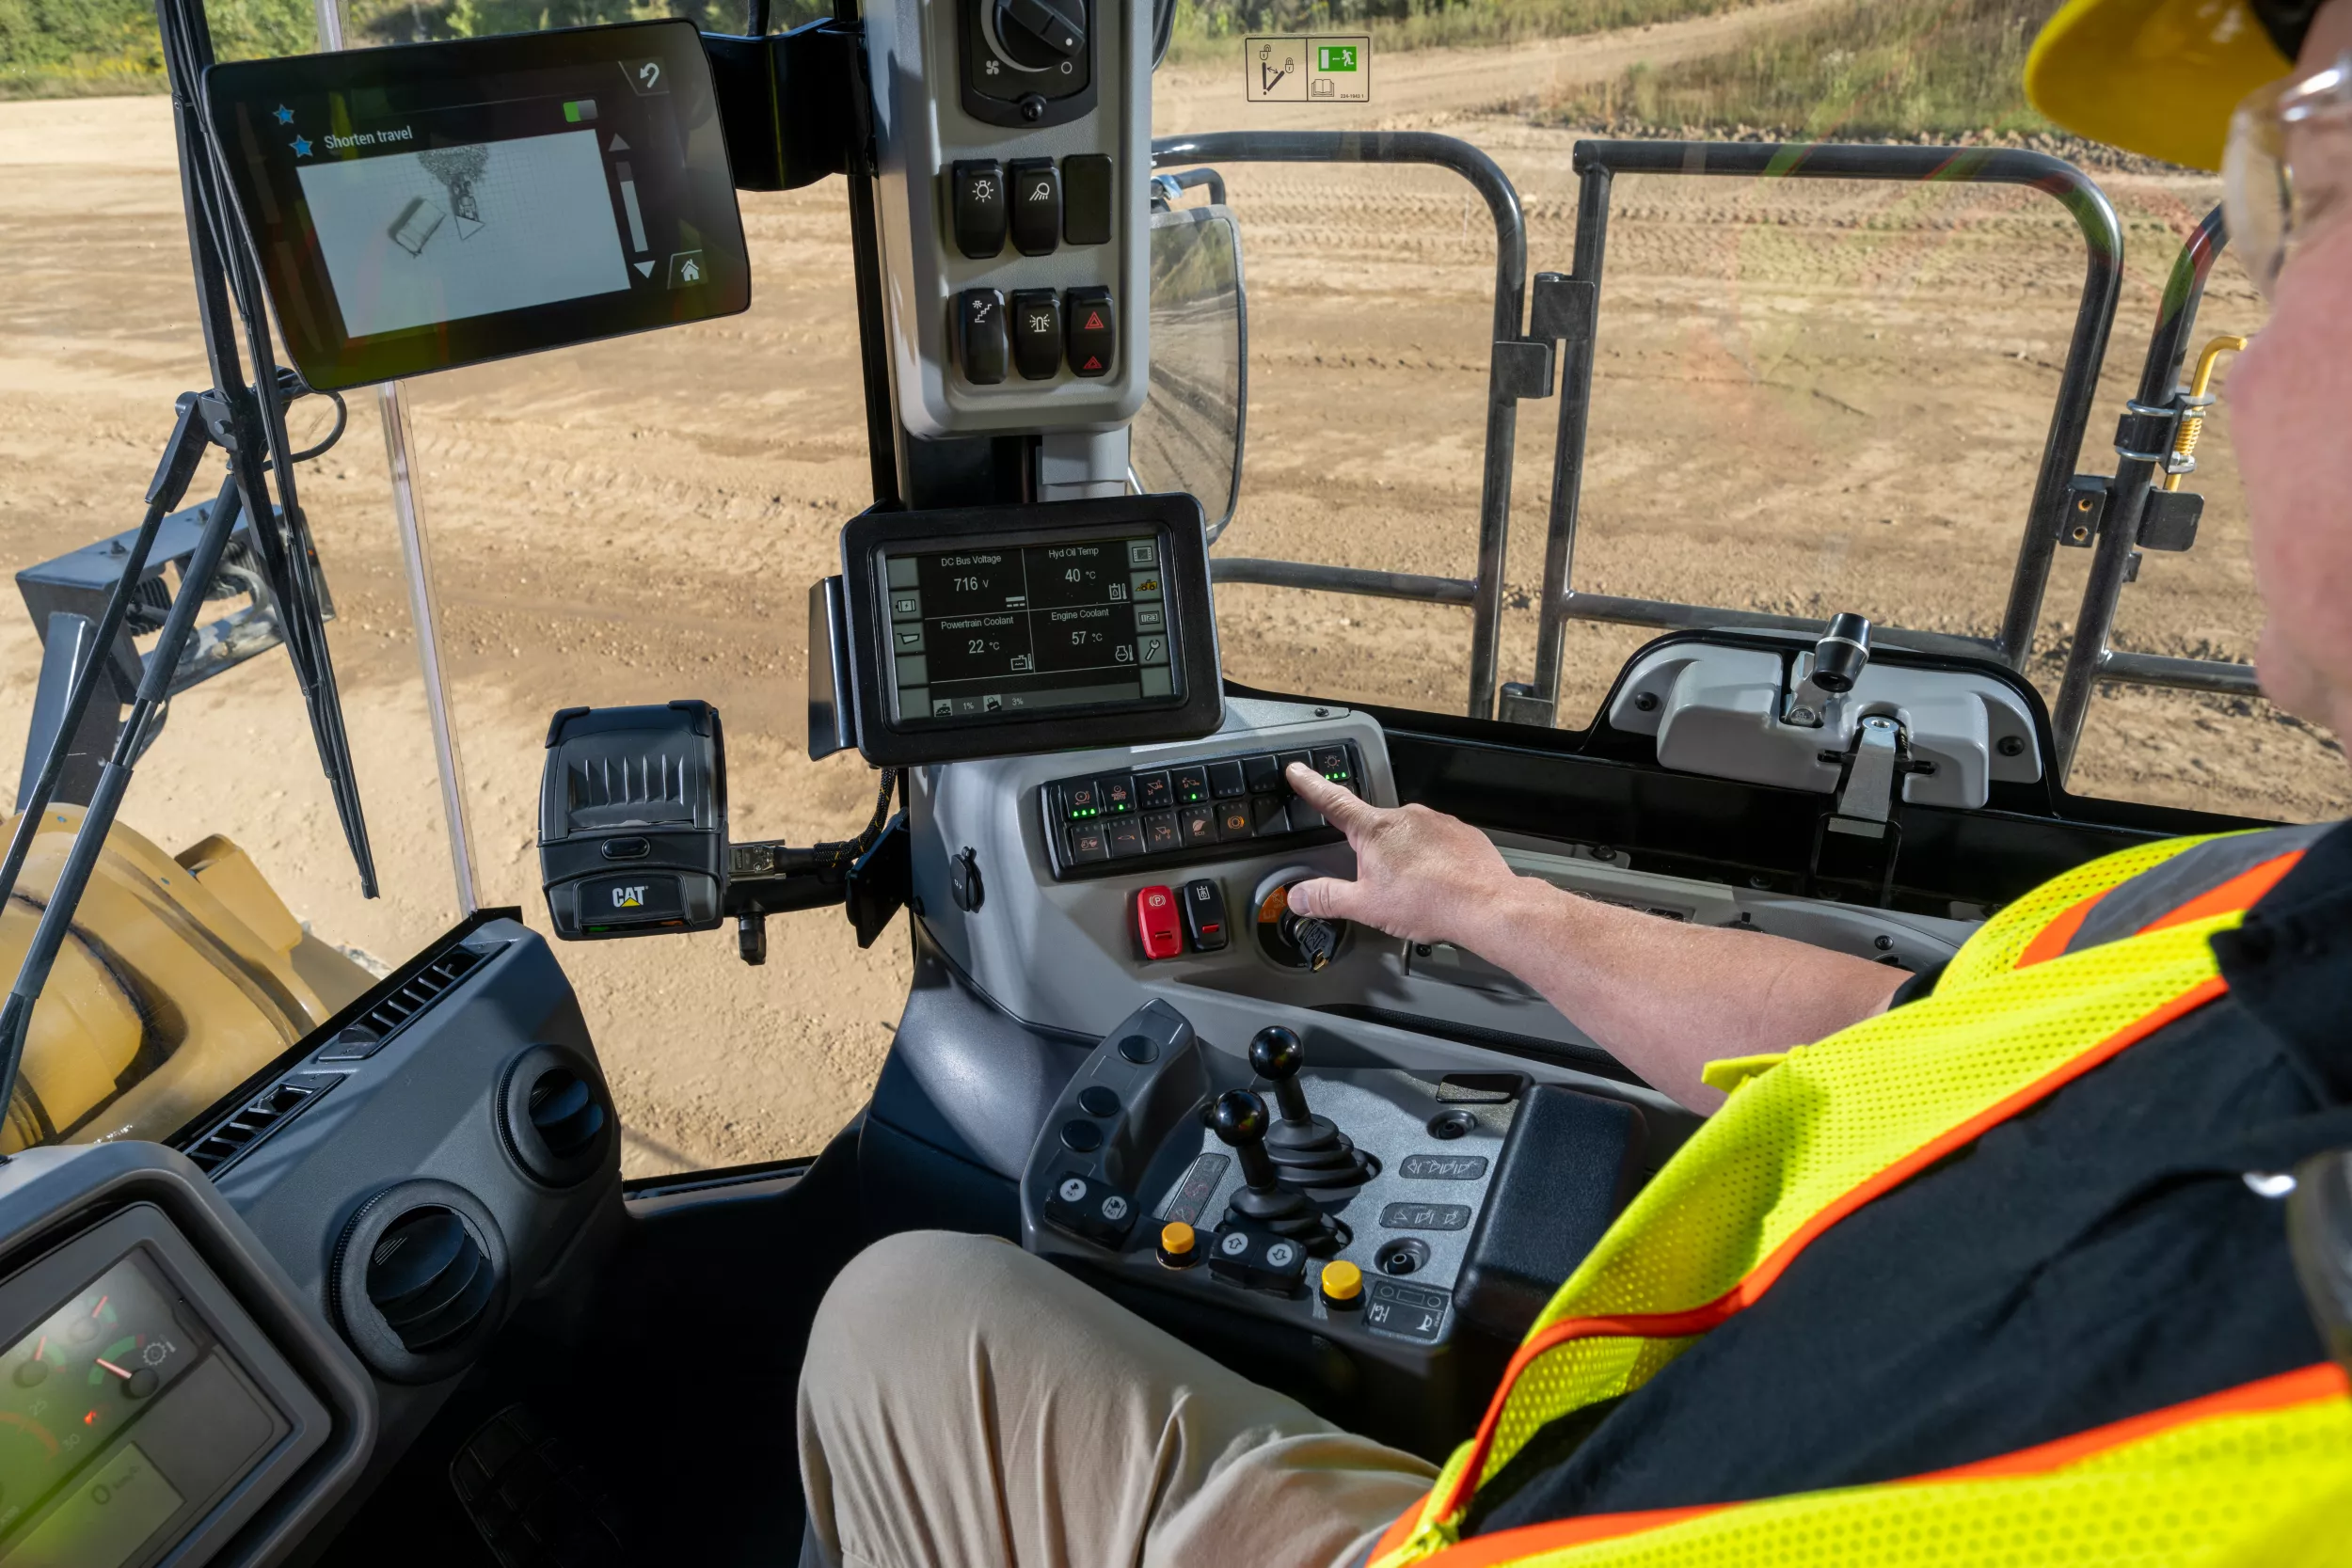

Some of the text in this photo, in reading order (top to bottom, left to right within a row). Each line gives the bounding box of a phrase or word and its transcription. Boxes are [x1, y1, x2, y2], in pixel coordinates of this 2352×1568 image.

[324, 125, 413, 150] Shorten travel
[1048, 546, 1100, 560] Hyd Oil Temp
[941, 555, 1001, 567] DC Bus Voltage
[1065, 568, 1081, 582] 40
[953, 577, 989, 592] 716 V
[1051, 609, 1109, 621] Engine Coolant
[941, 616, 1014, 629] Powertrain Coolant
[1072, 630, 1087, 645] 57
[968, 640, 984, 654] 22
[962, 702, 975, 710] 1%
[1011, 697, 1024, 706] 3%
[612, 886, 644, 908] CAT
